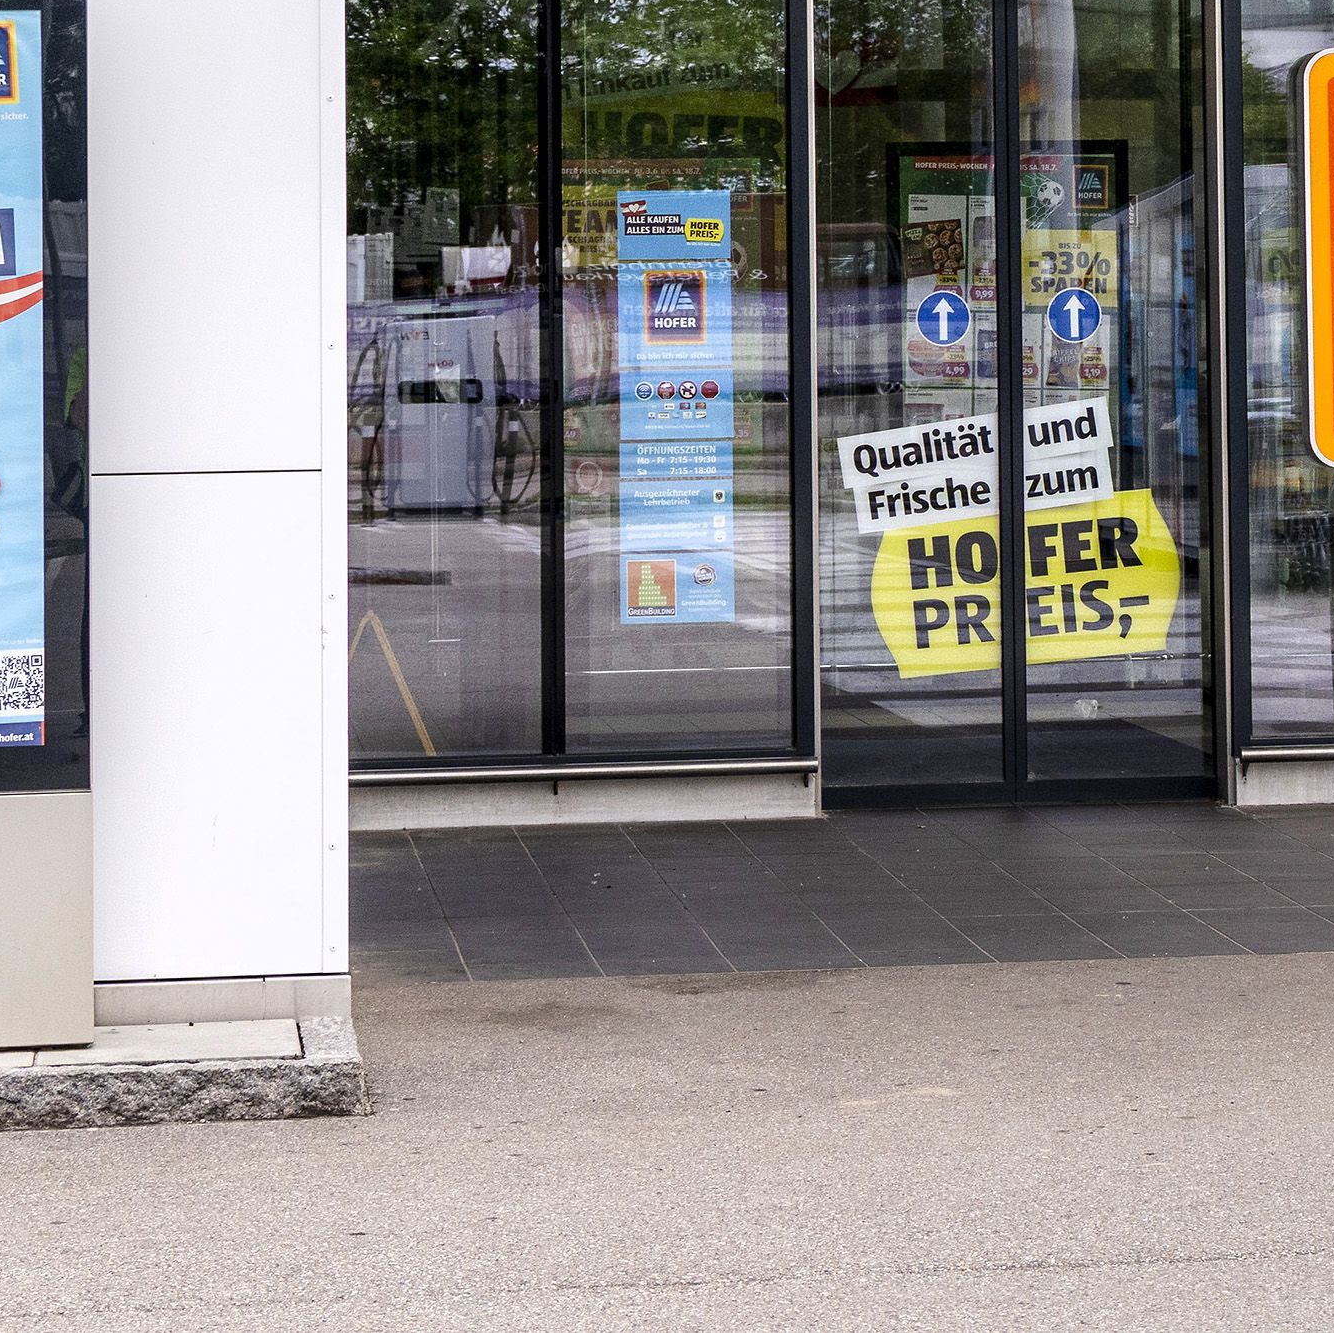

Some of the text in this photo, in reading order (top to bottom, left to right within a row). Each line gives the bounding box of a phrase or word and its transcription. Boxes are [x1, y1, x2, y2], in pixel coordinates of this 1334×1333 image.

[0, 112, 29, 121] sicher.
[626, 216, 679, 224] ALLE KAUFEN
[626, 226, 685, 234] ALLES EIN ZUM
[690, 221, 719, 230] HOFER
[690, 230, 719, 239] PREIS,-
[1029, 251, 1111, 276] -33%
[1031, 277, 1107, 294] SPAREN
[975, 289, 994, 299] 9,99
[654, 316, 696, 329] HOFER
[946, 366, 965, 376] 4,99
[1083, 368, 1101, 378] 1,19
[853, 407, 1098, 478] Qualität und
[637, 444, 716, 454] ÖFFNUNGSZEITEN
[670, 456, 687, 464] 7:15
[670, 467, 687, 475] 7:15
[634, 489, 700, 499] Ausgezeichneter
[868, 465, 1100, 521] Frische zum
[643, 498, 690, 506] Lehrbetrieb
[906, 516, 1143, 591] HOFER
